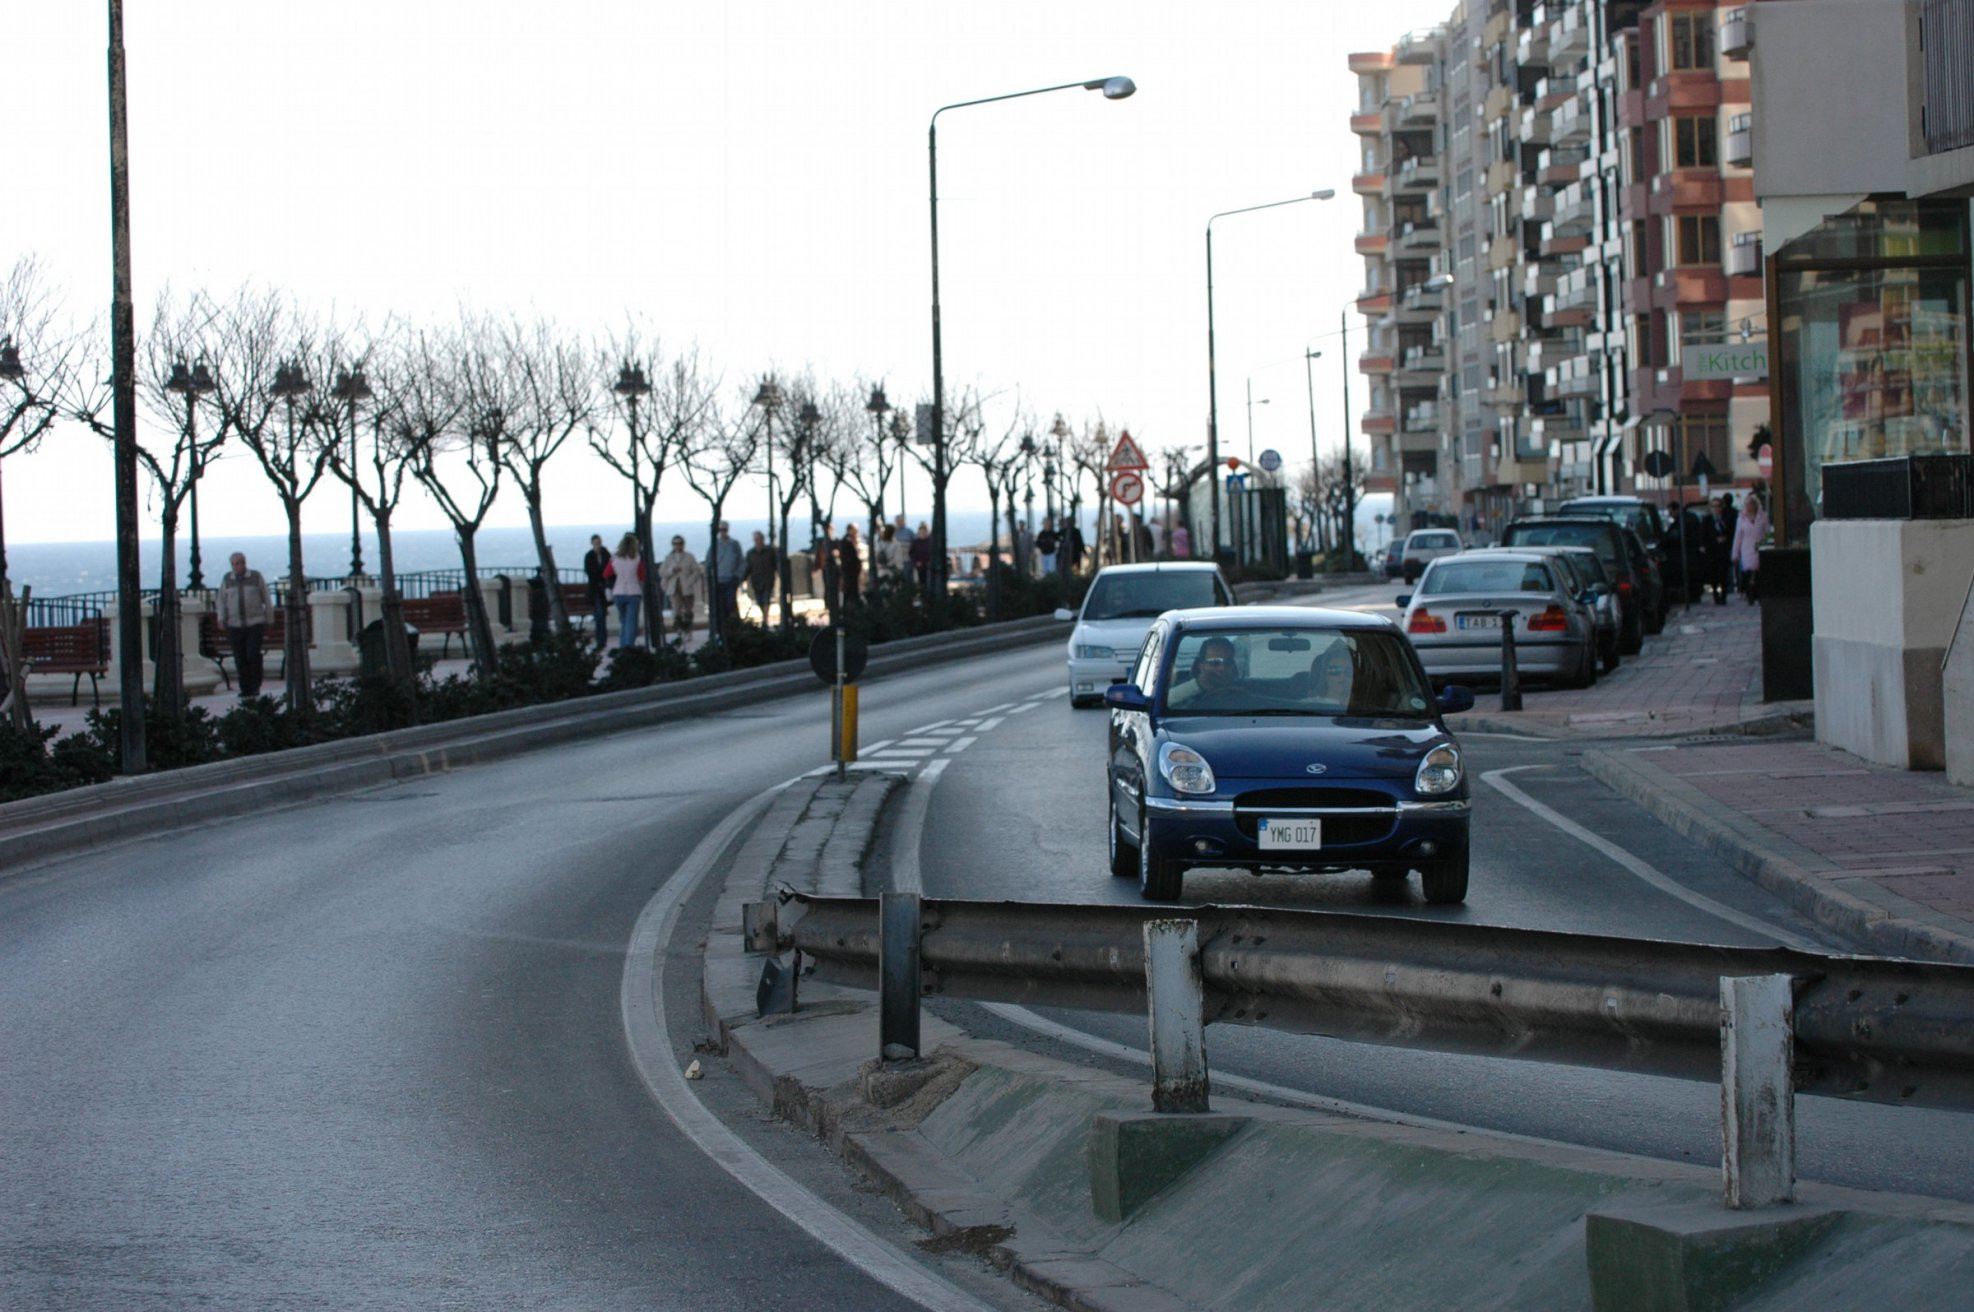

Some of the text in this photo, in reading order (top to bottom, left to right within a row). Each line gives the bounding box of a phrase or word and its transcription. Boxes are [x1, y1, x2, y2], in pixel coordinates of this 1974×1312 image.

[1708, 349, 1767, 372] Kitch
[1270, 826, 1317, 843] YMG 017
